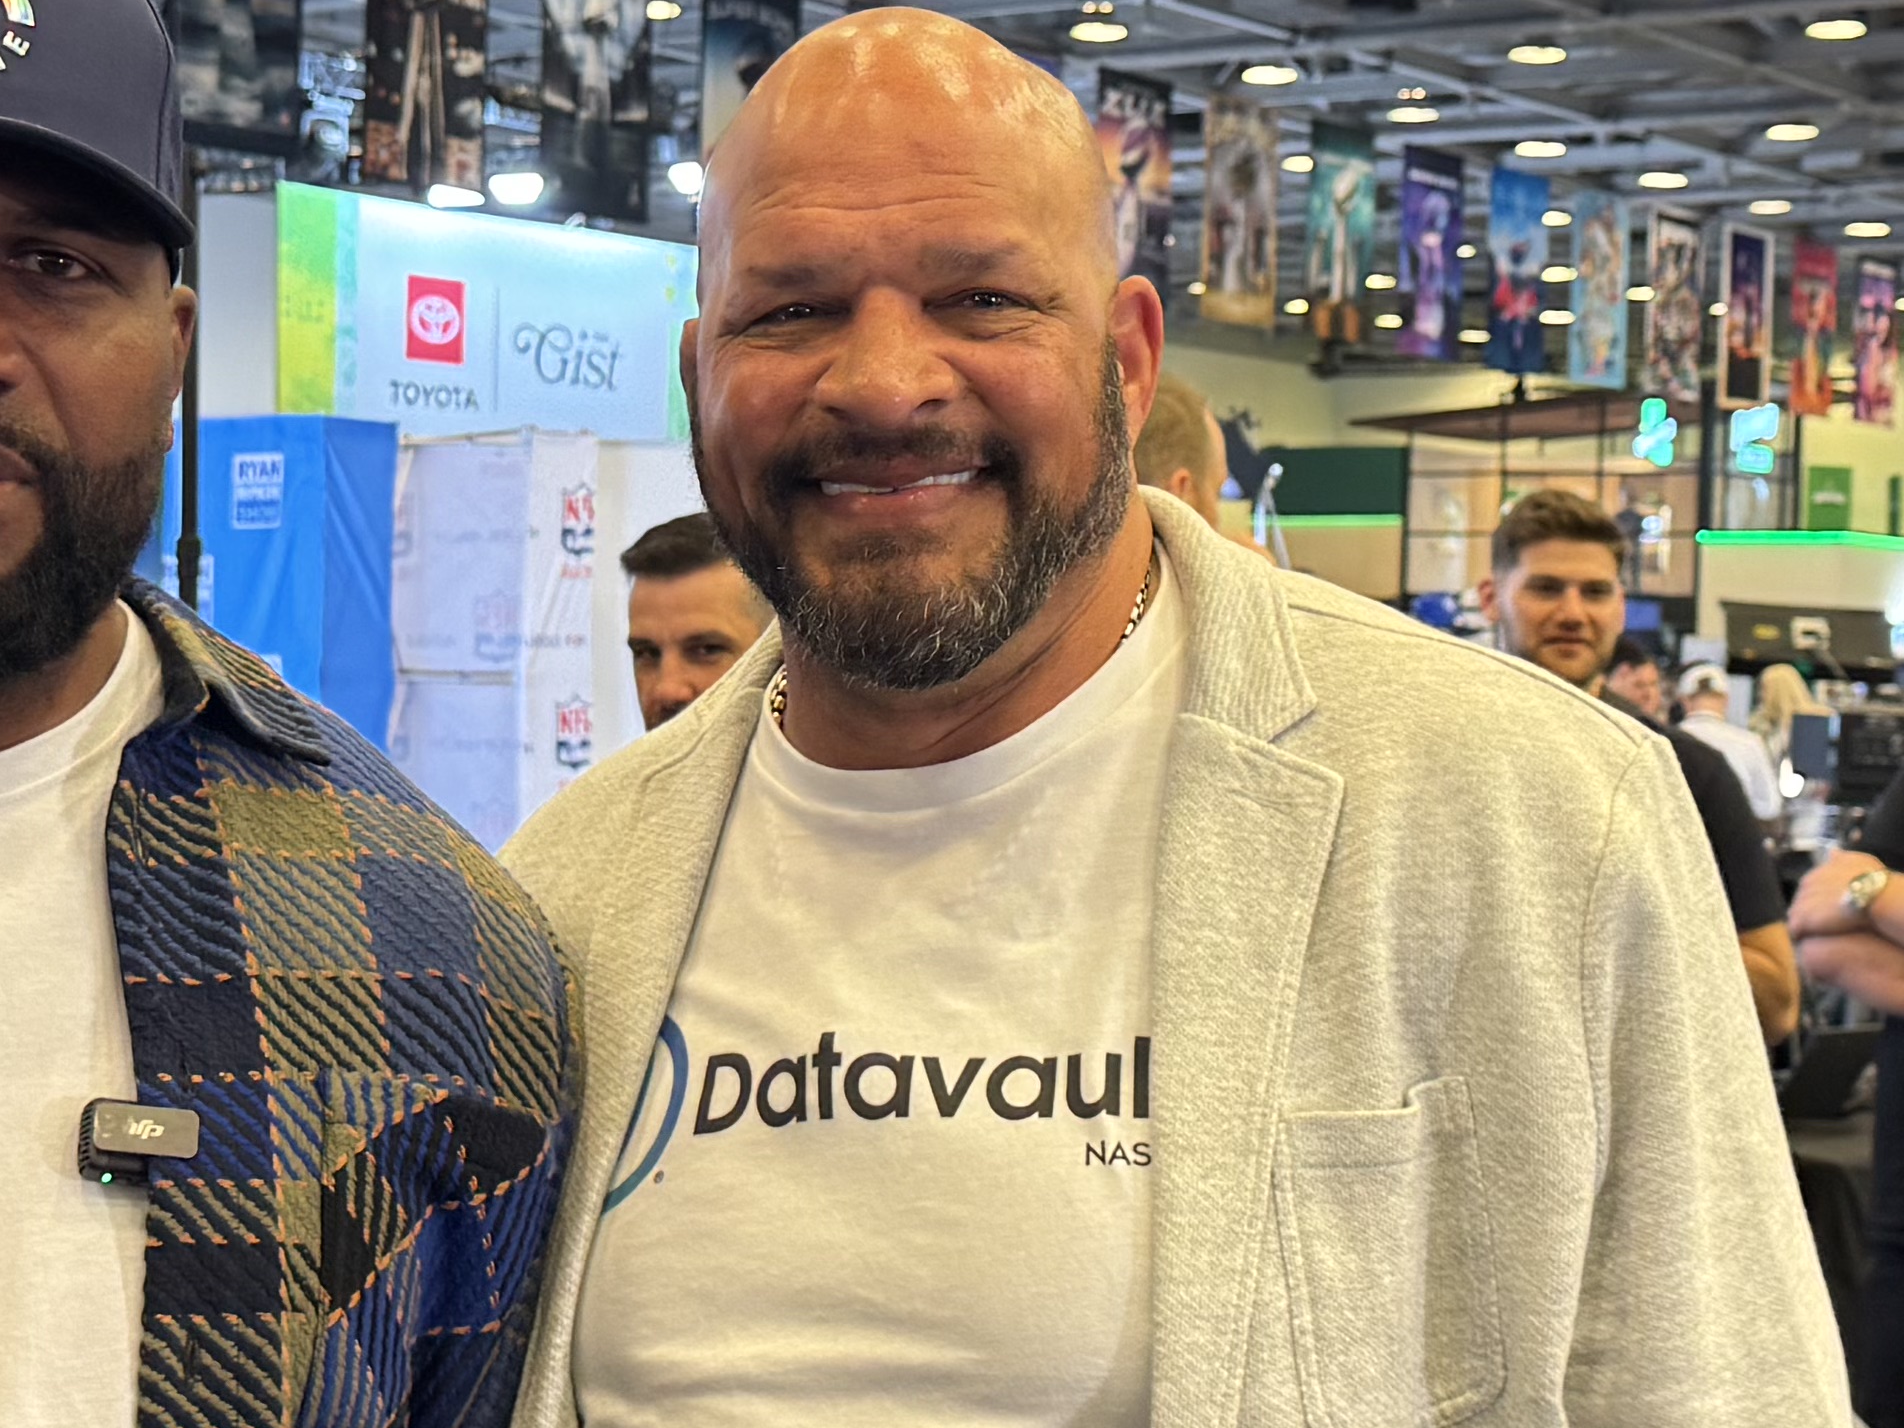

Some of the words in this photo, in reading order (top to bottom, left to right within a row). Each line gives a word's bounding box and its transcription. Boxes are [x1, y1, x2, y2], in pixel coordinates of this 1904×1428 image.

[389, 378, 480, 411] TOYOTA
[692, 1030, 1152, 1136] Datavaul
[1083, 1139, 1152, 1168] NAS
